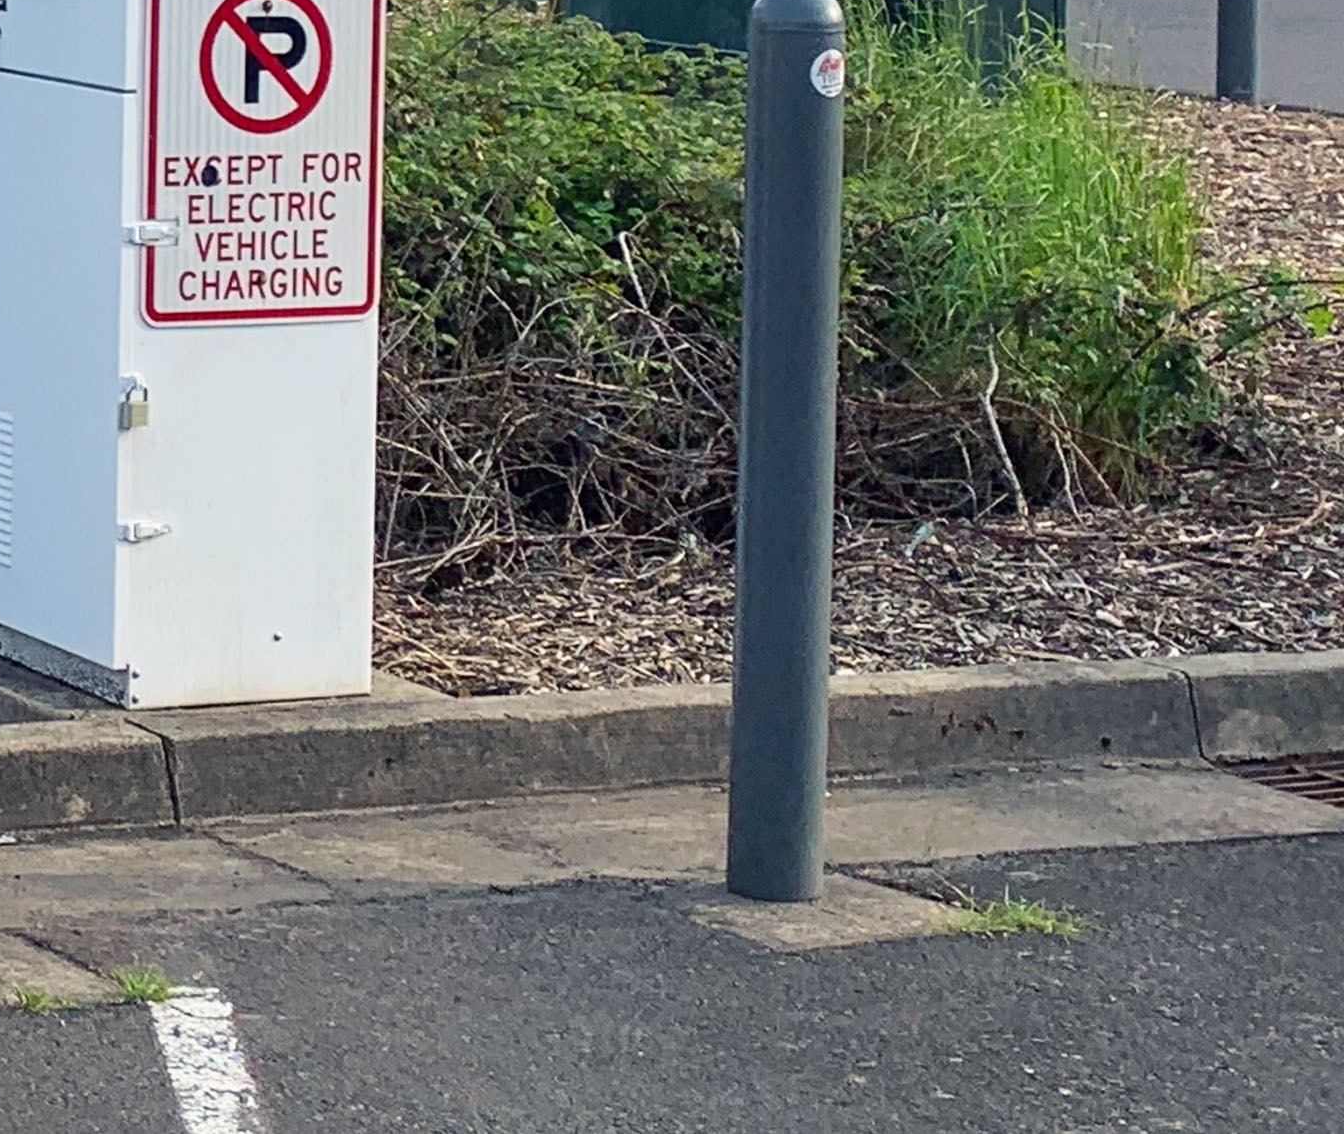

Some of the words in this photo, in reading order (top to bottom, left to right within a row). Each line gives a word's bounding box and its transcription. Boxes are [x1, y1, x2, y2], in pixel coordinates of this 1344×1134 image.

[302, 152, 362, 183] FOR
[188, 190, 337, 225] ELECTRIC
[194, 229, 329, 262] VEHICLE
[179, 267, 343, 301] CHARGING
